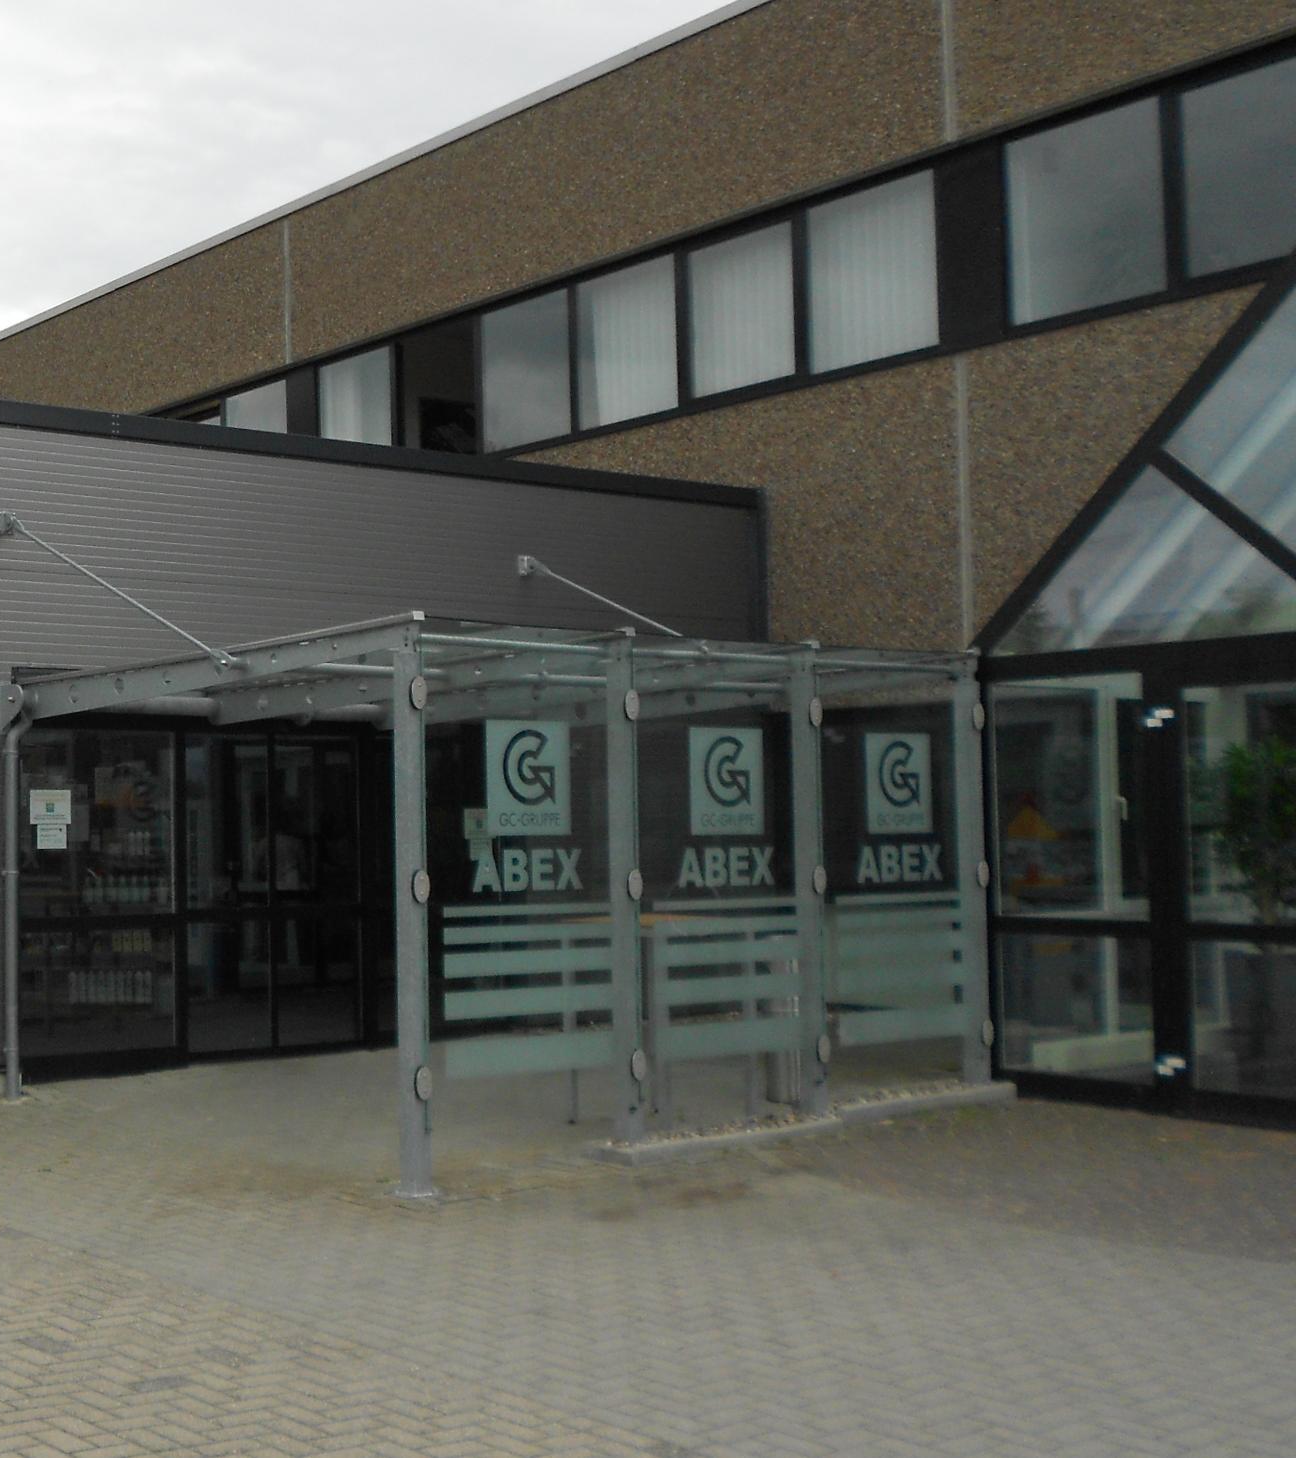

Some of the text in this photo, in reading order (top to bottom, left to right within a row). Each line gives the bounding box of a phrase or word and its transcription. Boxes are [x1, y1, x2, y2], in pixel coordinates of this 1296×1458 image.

[499, 812, 561, 827] GC-GRUPPE
[472, 848, 583, 893] ABEX
[678, 846, 776, 888] ABEX
[856, 844, 943, 884] ABEX
